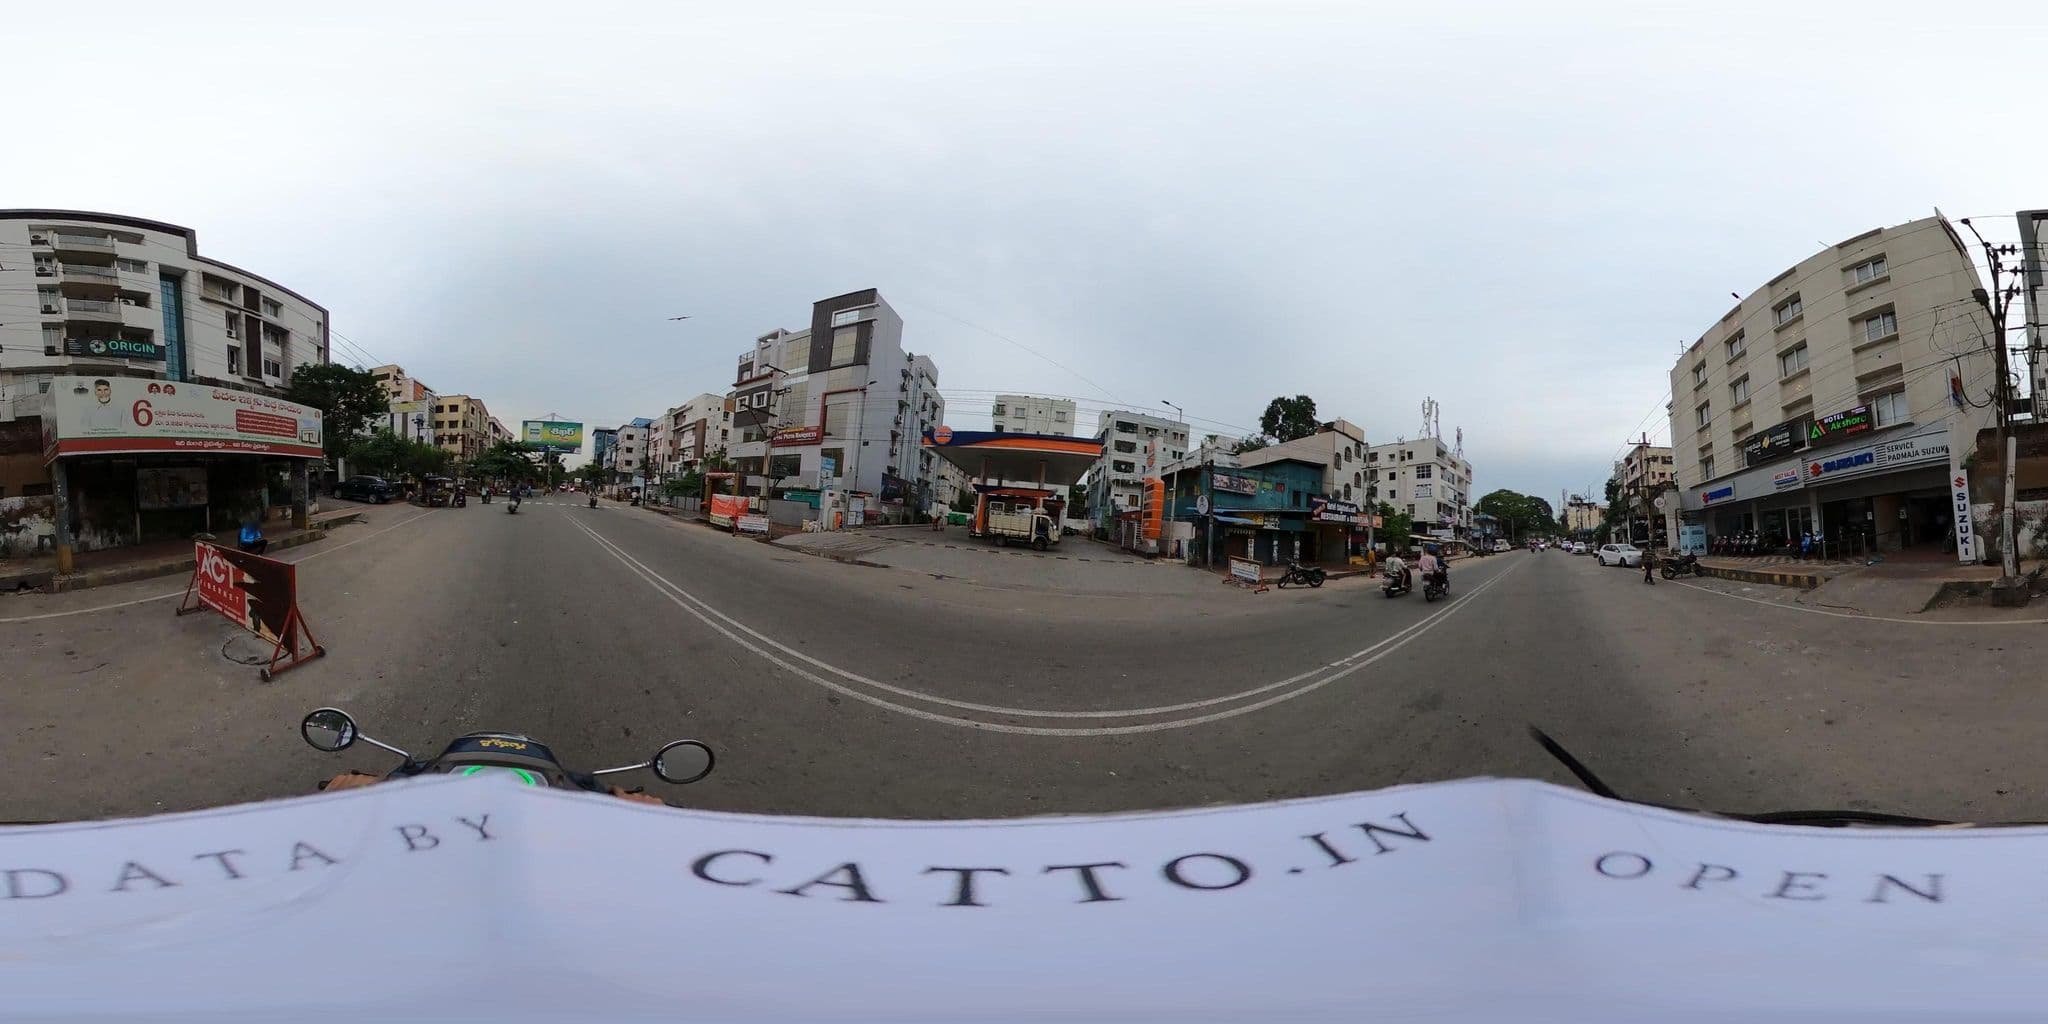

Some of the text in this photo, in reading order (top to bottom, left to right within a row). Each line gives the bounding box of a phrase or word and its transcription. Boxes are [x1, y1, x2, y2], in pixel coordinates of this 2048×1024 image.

[108, 340, 155, 354] ORIGIN
[132, 399, 154, 427] 6
[1822, 452, 1874, 473] SUZUKI
[1886, 441, 1914, 453] SERVICE
[1887, 450, 1920, 462] PADMAJA
[1956, 492, 1969, 556] SUZUKI
[201, 552, 238, 590] ACT
[1, 813, 498, 899] DATA BY
[690, 811, 1433, 908] CATTO.IN
[1594, 850, 1946, 904] OPEN
